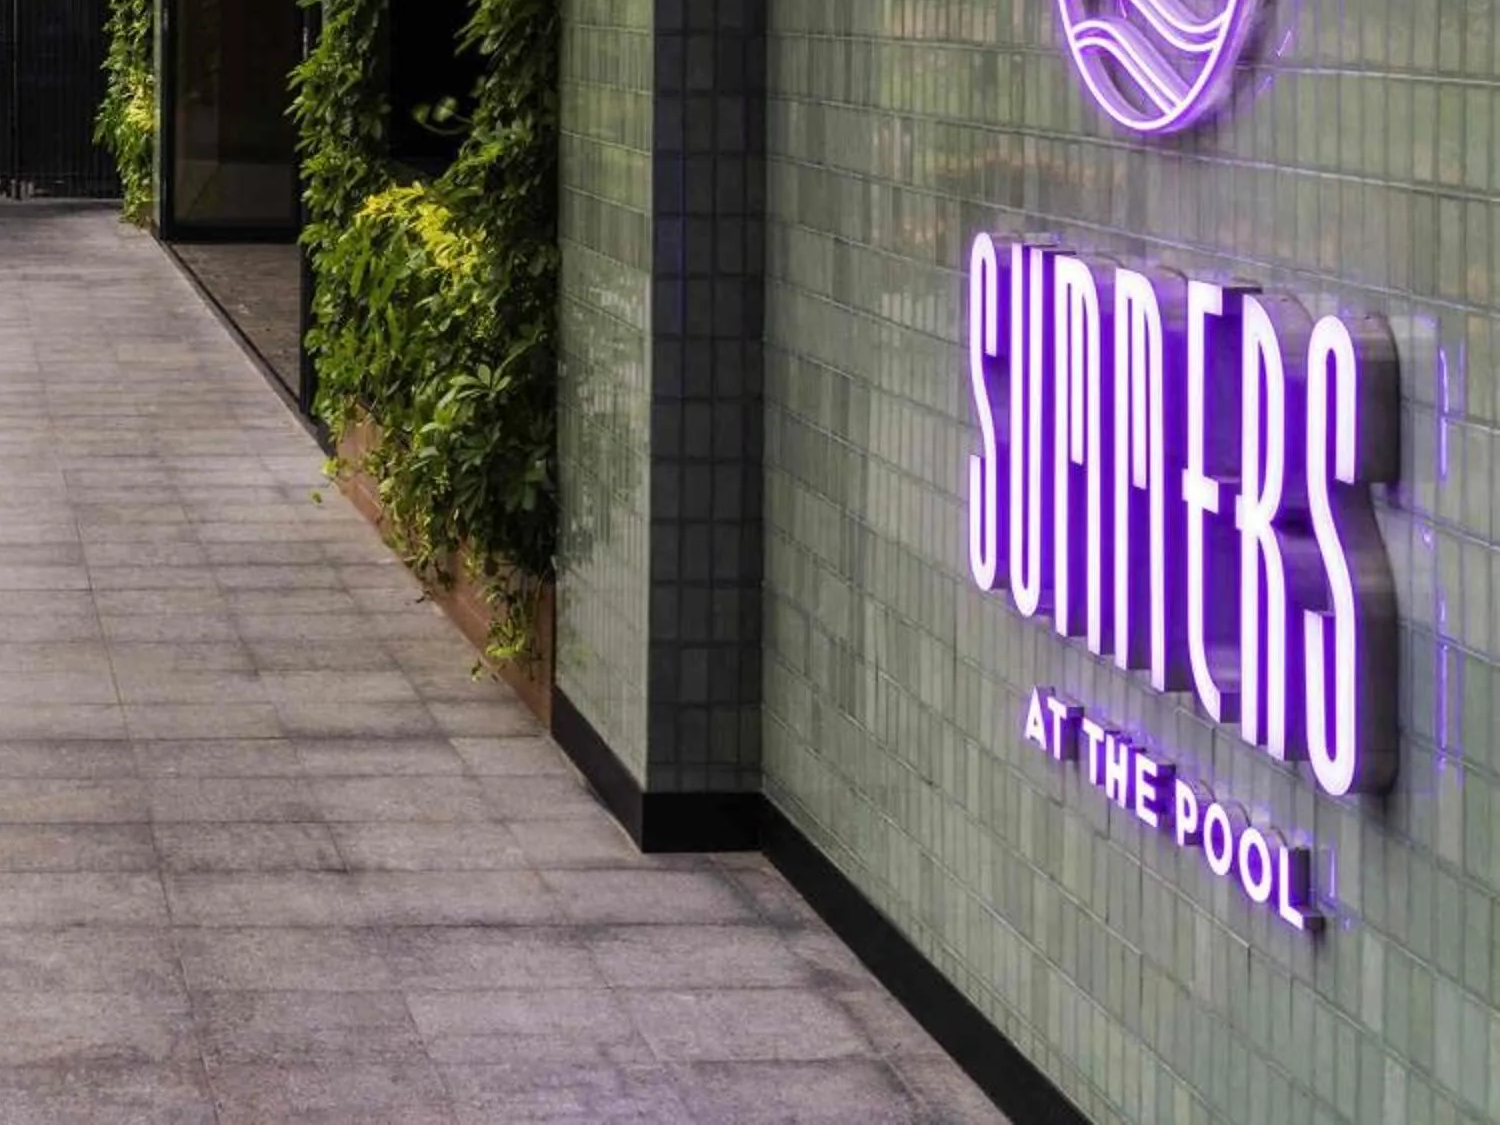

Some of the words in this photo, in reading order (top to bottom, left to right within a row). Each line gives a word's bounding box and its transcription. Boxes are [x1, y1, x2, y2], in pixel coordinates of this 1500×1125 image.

[969, 231, 1357, 797] SUMMERS
[1025, 686, 1067, 760] AT
[1082, 718, 1158, 827] THE
[1175, 779, 1304, 930] POOL
